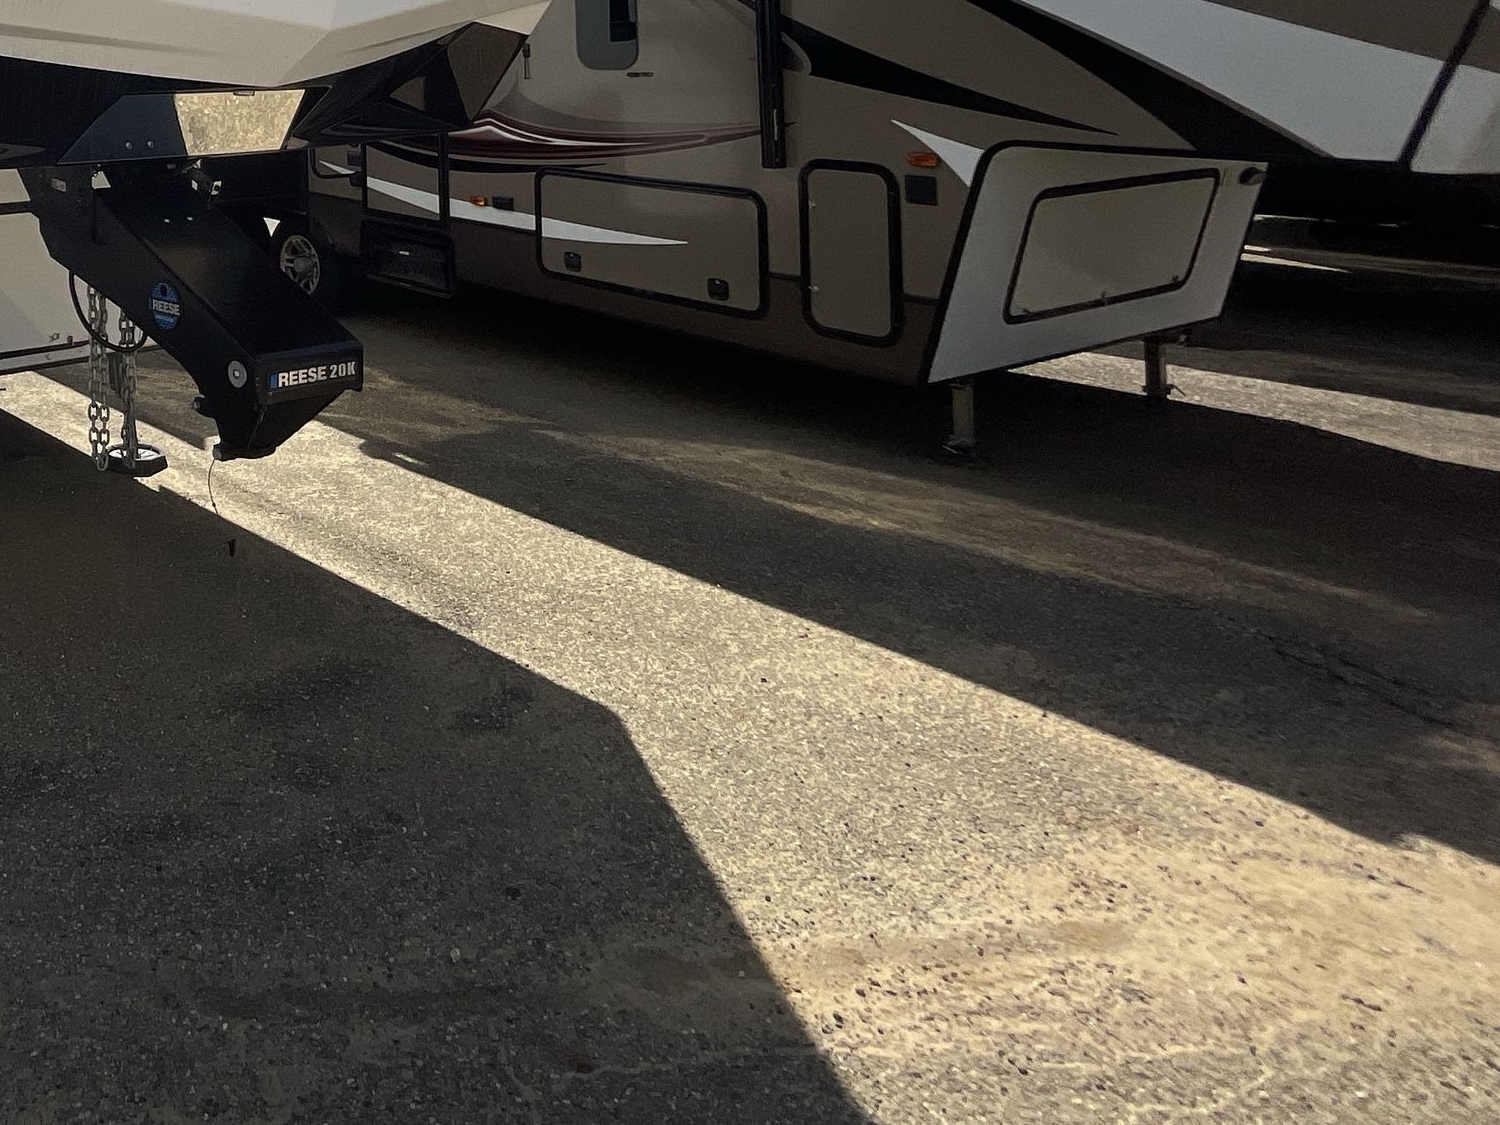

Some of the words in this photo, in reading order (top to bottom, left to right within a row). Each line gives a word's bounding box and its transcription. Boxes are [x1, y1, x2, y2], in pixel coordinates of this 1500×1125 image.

[152, 298, 181, 316] REESE
[278, 366, 328, 388] REESE
[329, 361, 356, 379] 20K
